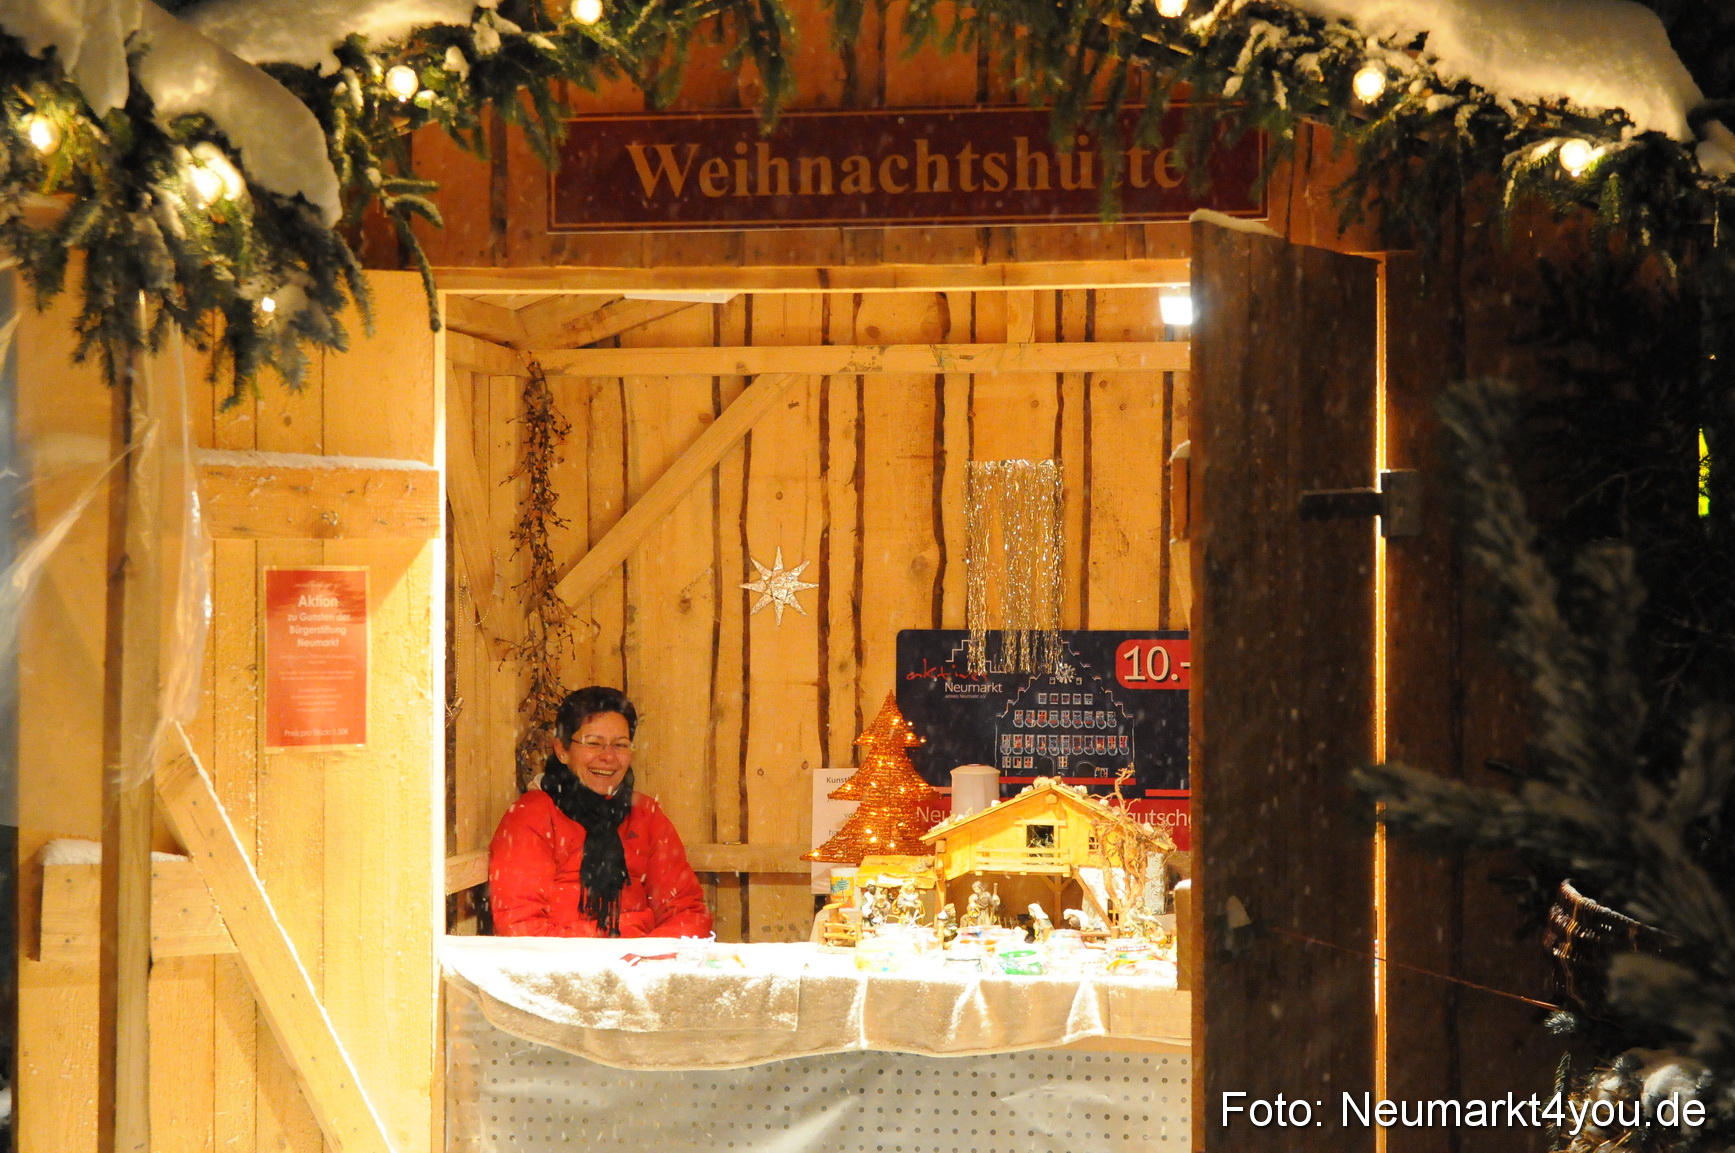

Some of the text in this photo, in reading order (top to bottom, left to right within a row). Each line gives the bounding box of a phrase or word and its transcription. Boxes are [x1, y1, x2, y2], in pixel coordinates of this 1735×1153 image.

[625, 136, 1186, 199] Weihnachtshüte
[298, 595, 339, 607] Aktion
[288, 613, 298, 622] zu
[299, 612, 335, 621] Gunsten
[289, 625, 346, 636] Bürgerstiftung
[297, 638, 339, 647] Neumarkt
[944, 682, 1003, 693] Neumarkt
